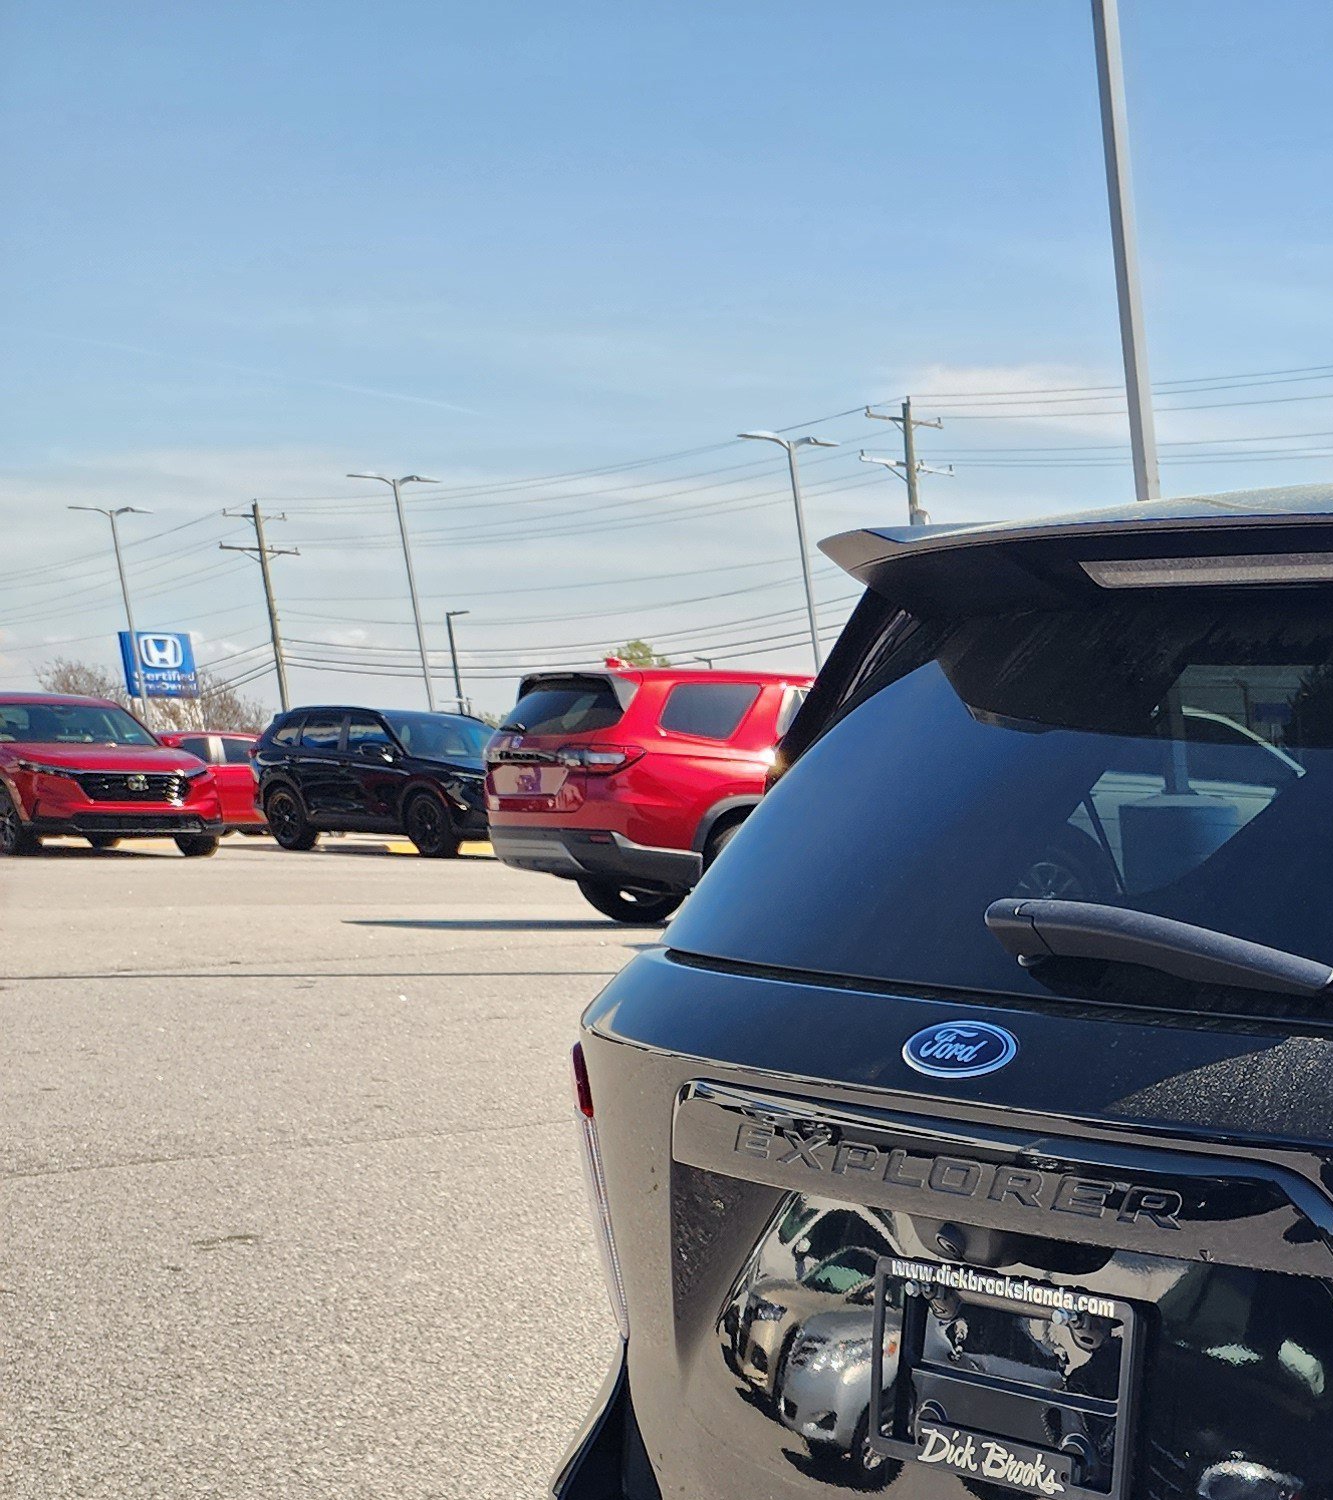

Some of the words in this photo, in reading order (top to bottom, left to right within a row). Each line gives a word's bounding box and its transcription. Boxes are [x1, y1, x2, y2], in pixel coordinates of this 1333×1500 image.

[919, 1027, 989, 1063] Ford
[734, 1122, 1182, 1231] EXPLORER
[891, 1259, 1115, 1319] www.dickbrookshonda.com
[917, 1427, 978, 1472] Dick
[981, 1440, 1066, 1495] Brooks
